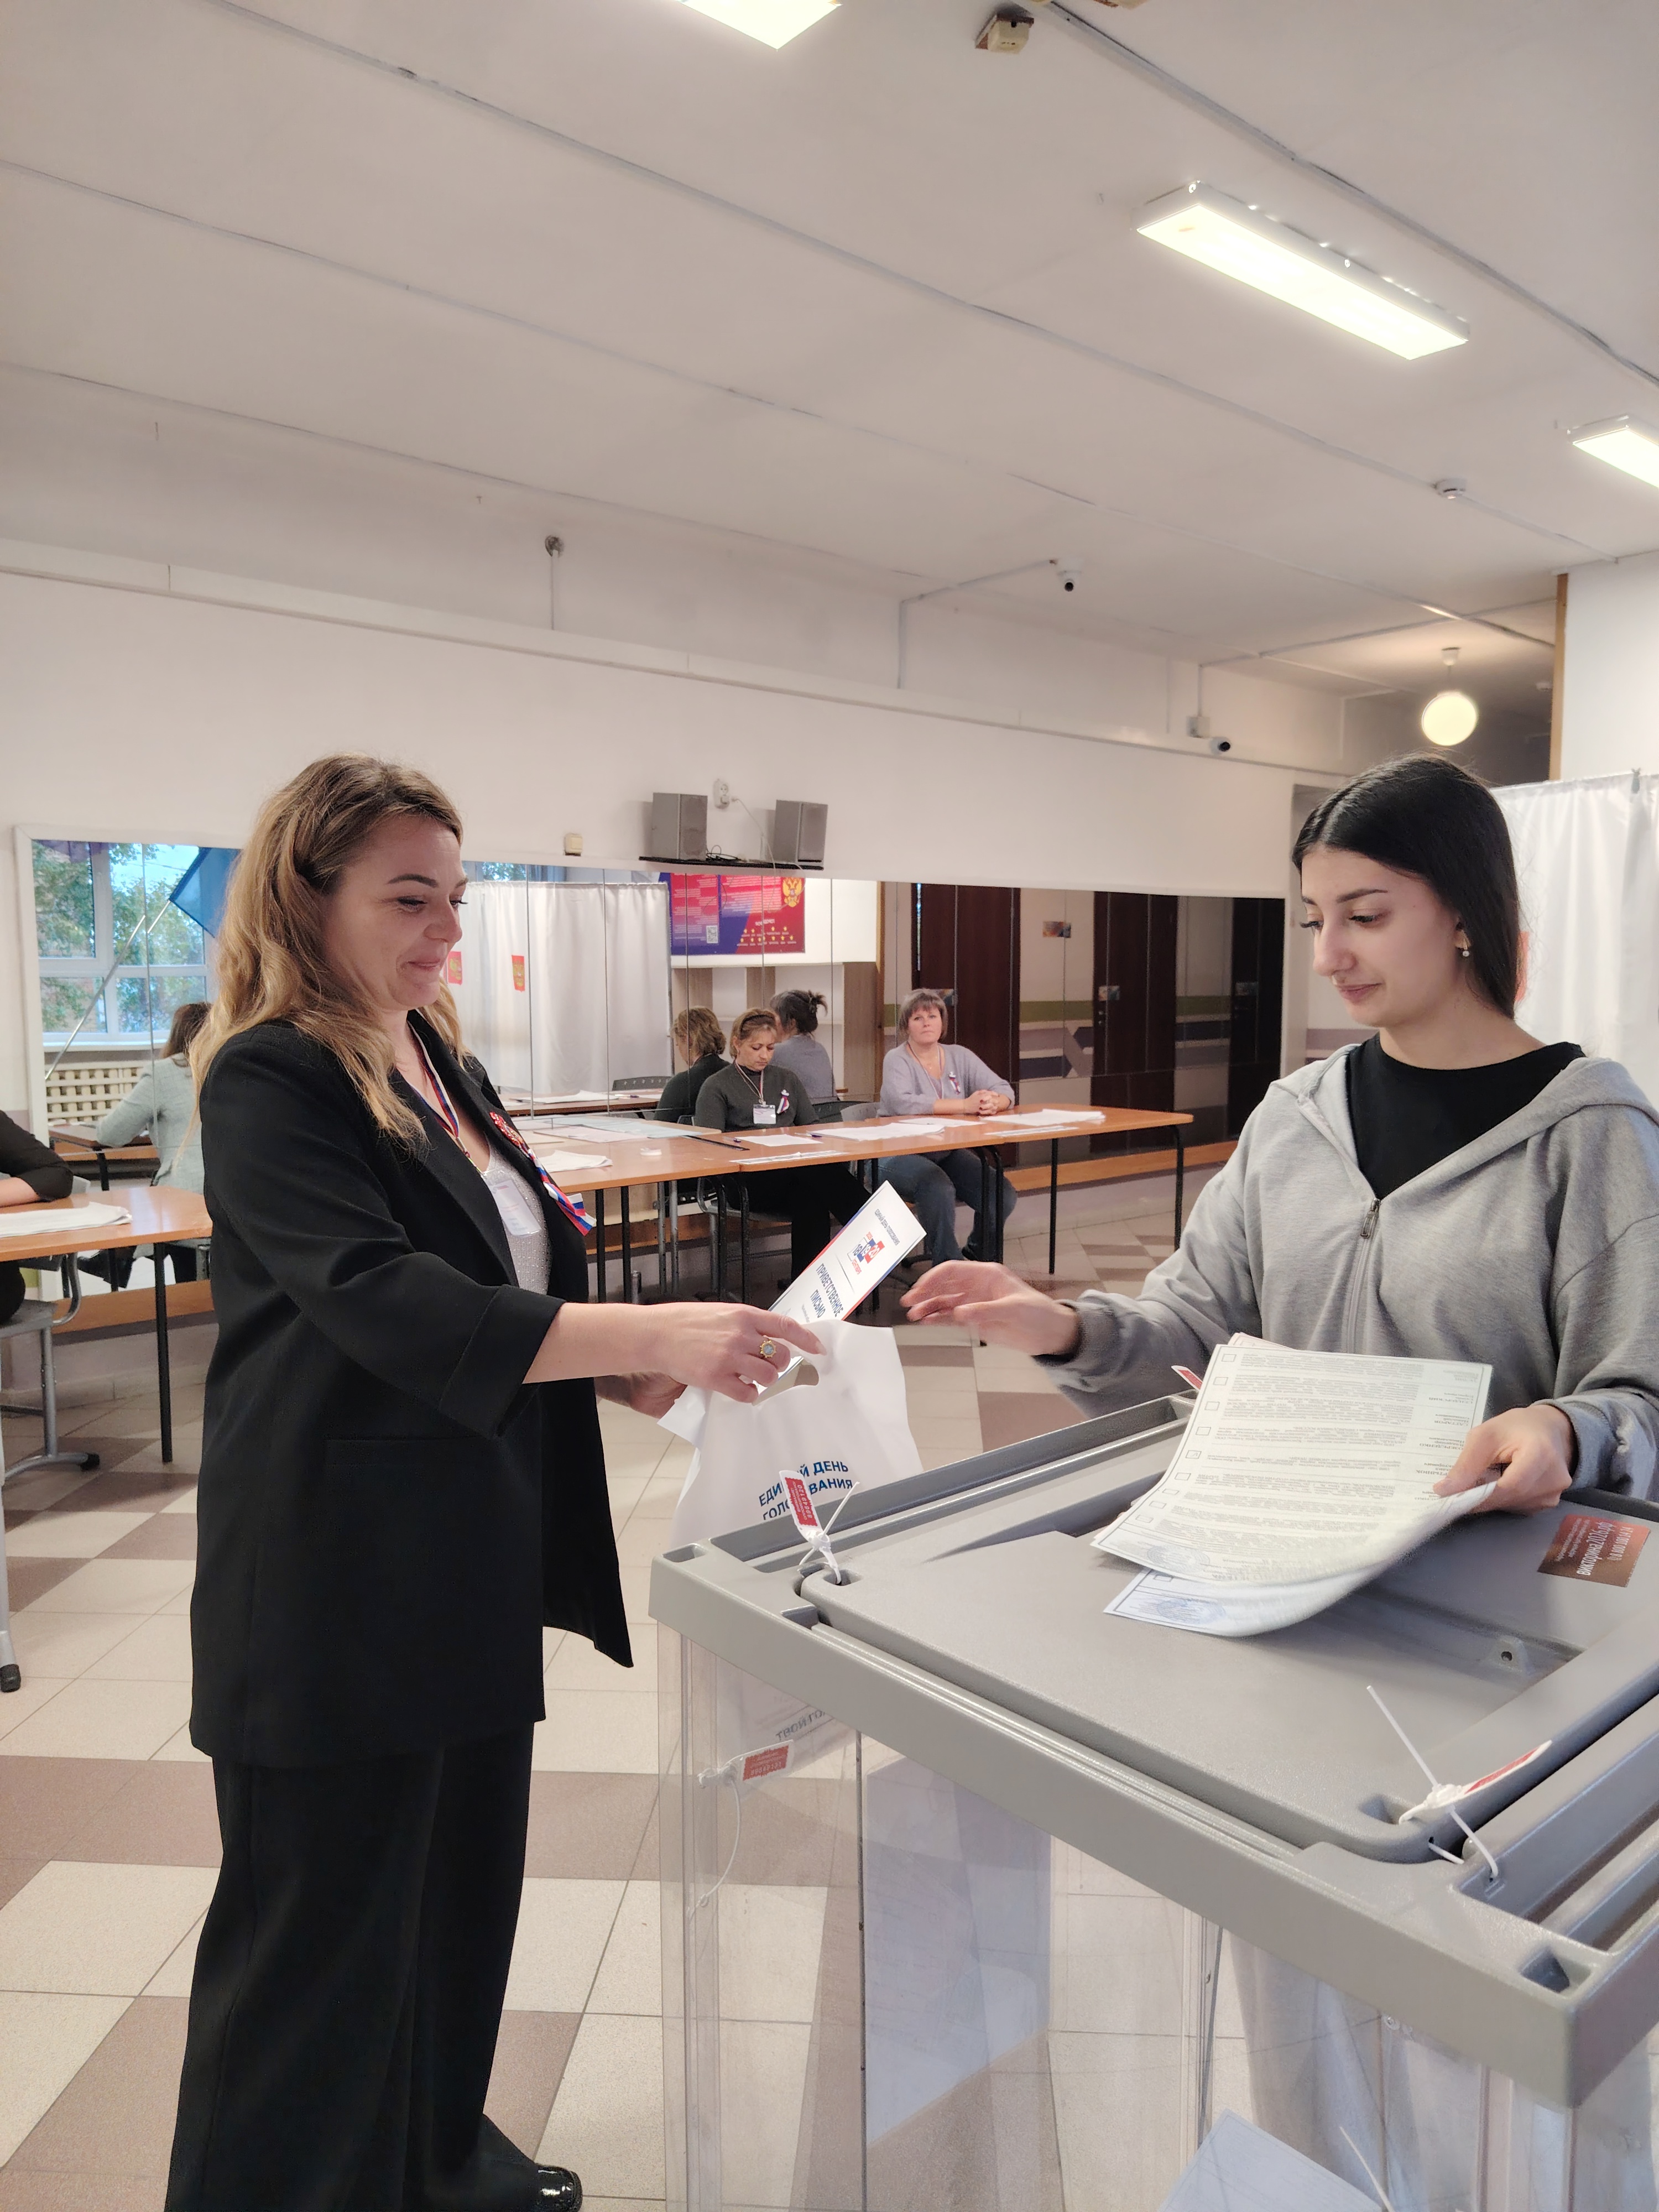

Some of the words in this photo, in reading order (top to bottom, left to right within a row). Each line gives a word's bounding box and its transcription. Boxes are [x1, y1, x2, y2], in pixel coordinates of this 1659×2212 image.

[852, 1244, 863, 1256] 18
[860, 1244, 872, 1257] 19
[868, 1244, 880, 1259] 20
[810, 1290, 826, 1318] ПИСЬМО
[816, 1263, 843, 1317] ПРИВЕТСТВЕННОЕ
[759, 1463, 810, 1507] ЕДИЙ
[813, 1460, 848, 1476] ДЕНЬ
[763, 1478, 853, 1520] ГОЛВАНИЯ
[775, 1715, 807, 1742] ТВОЙ
[808, 1709, 826, 1723] ГО
